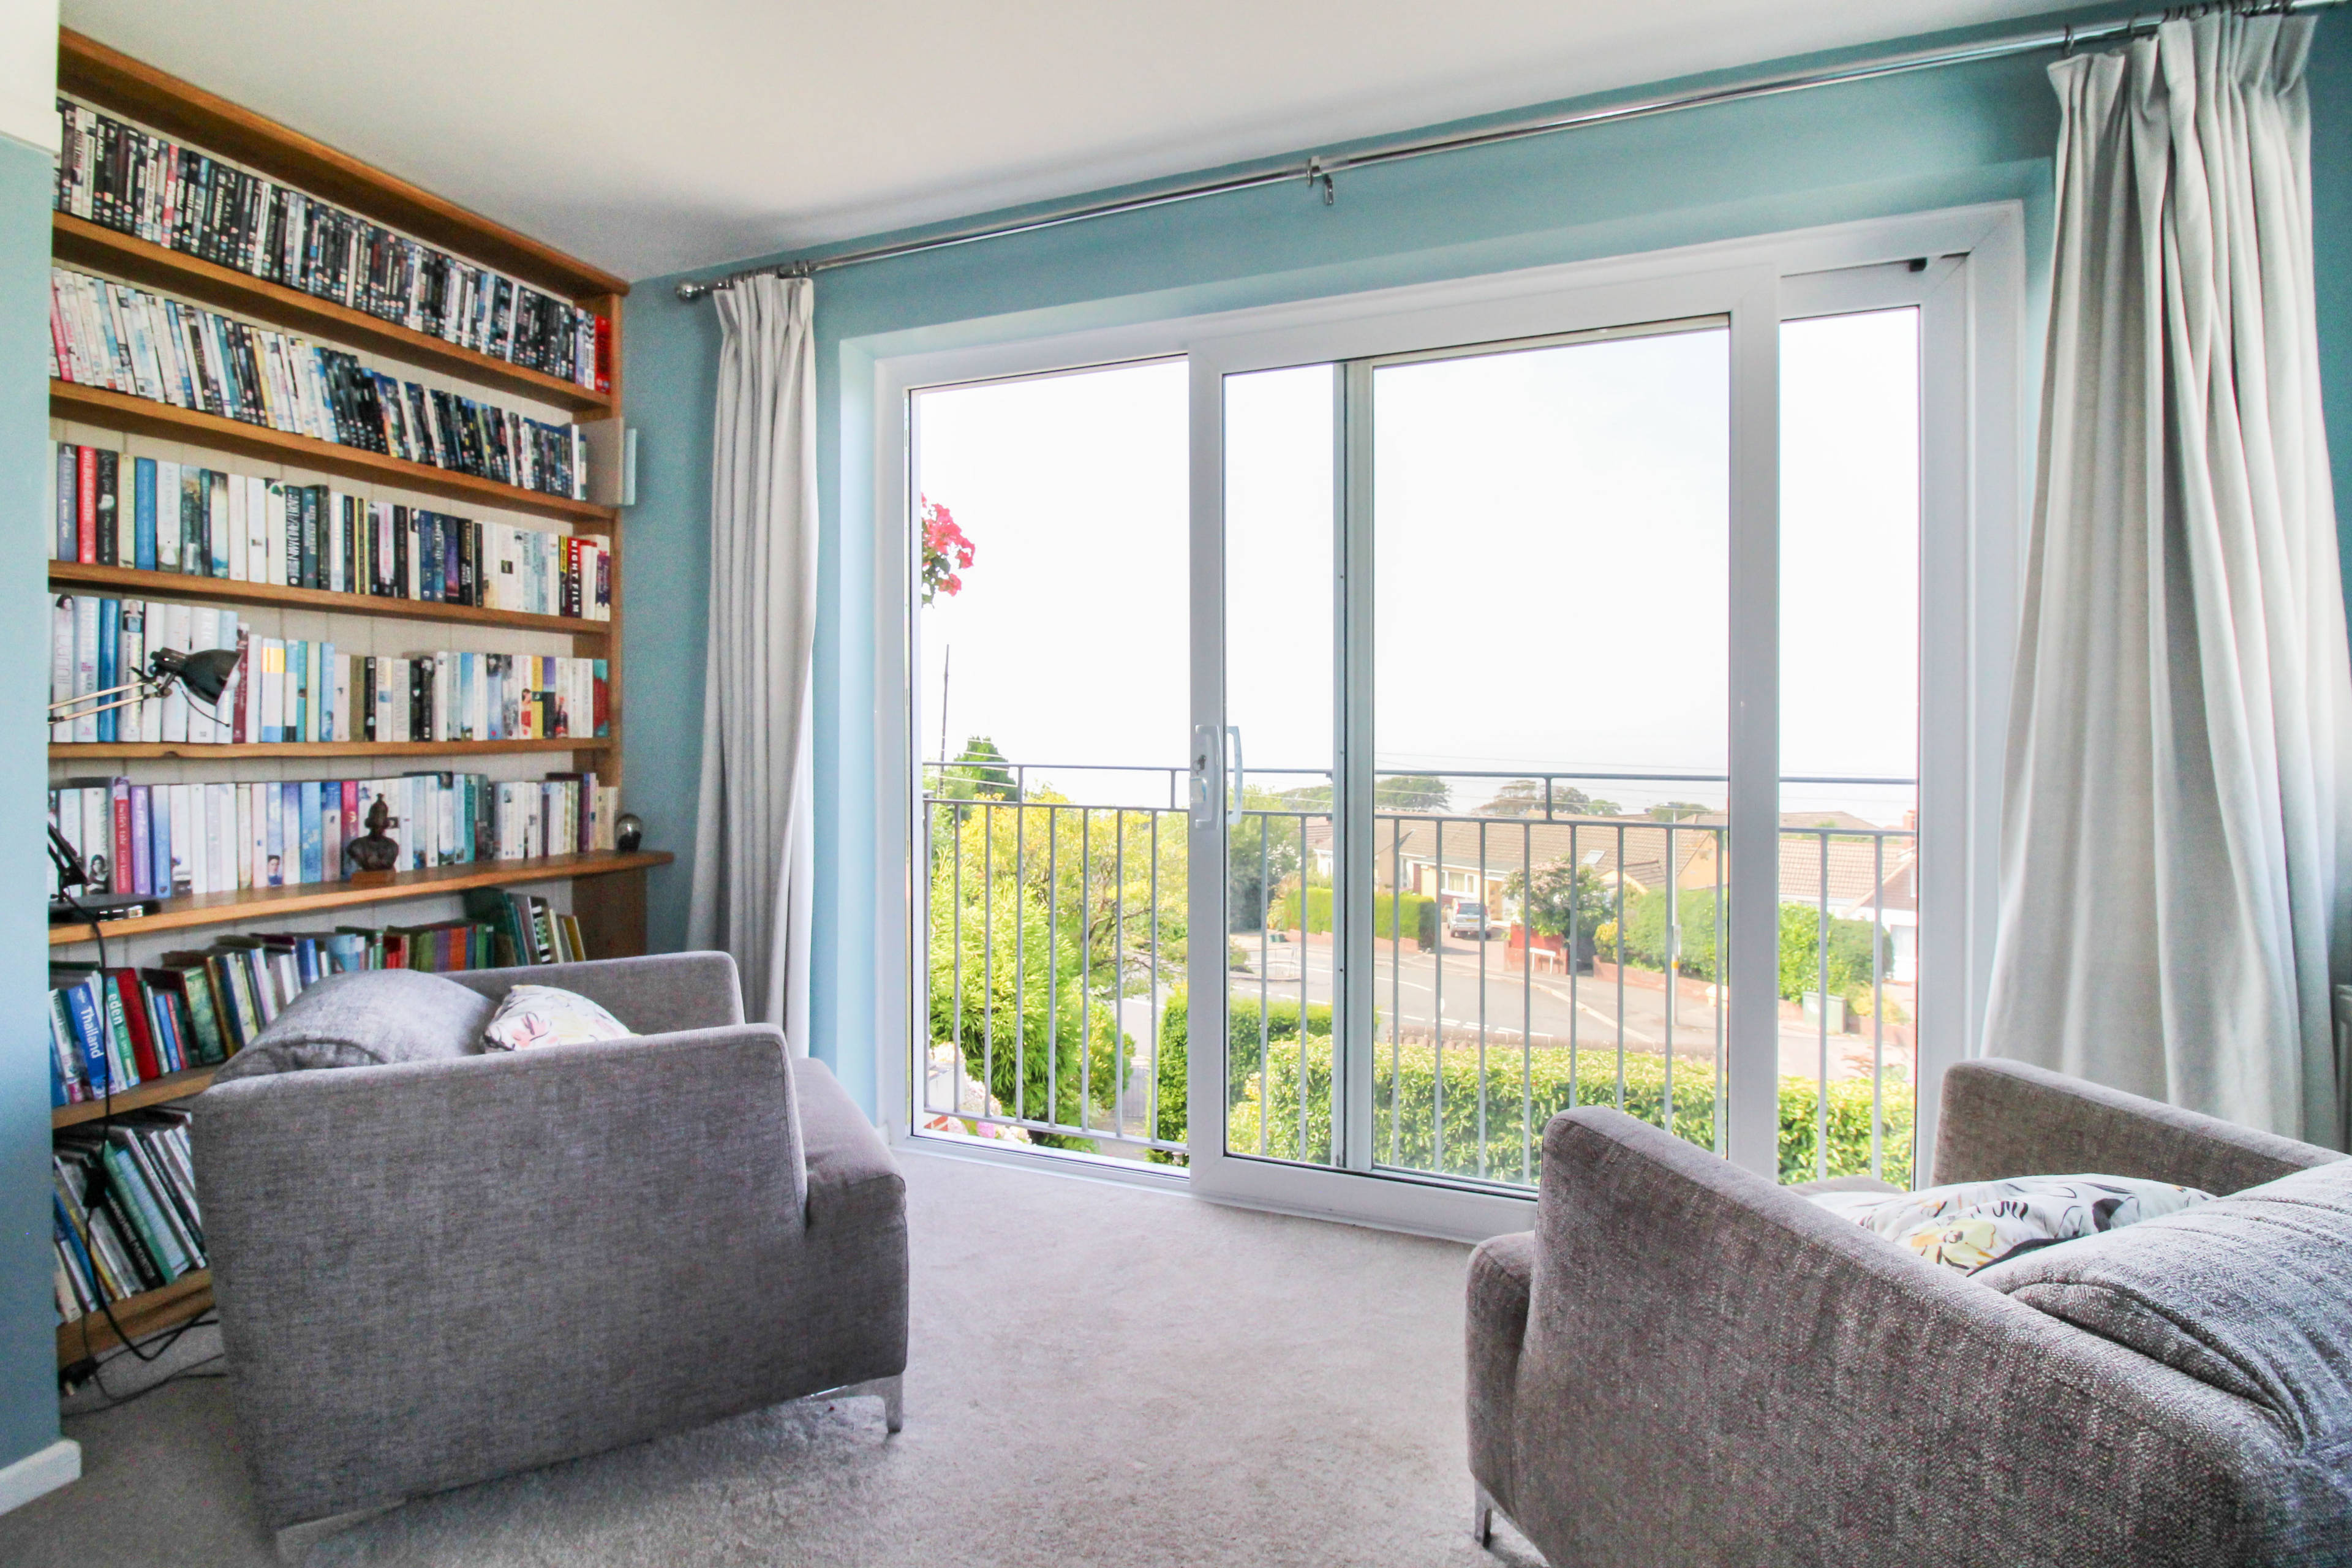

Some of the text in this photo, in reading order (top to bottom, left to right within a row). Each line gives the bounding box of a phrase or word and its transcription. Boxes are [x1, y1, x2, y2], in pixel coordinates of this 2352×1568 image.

[83, 451, 93, 521] WILBUR SMITH
[80, 602, 96, 662] RUSSELL
[80, 1006, 104, 1058] Thailand
[108, 993, 124, 1025] eden
